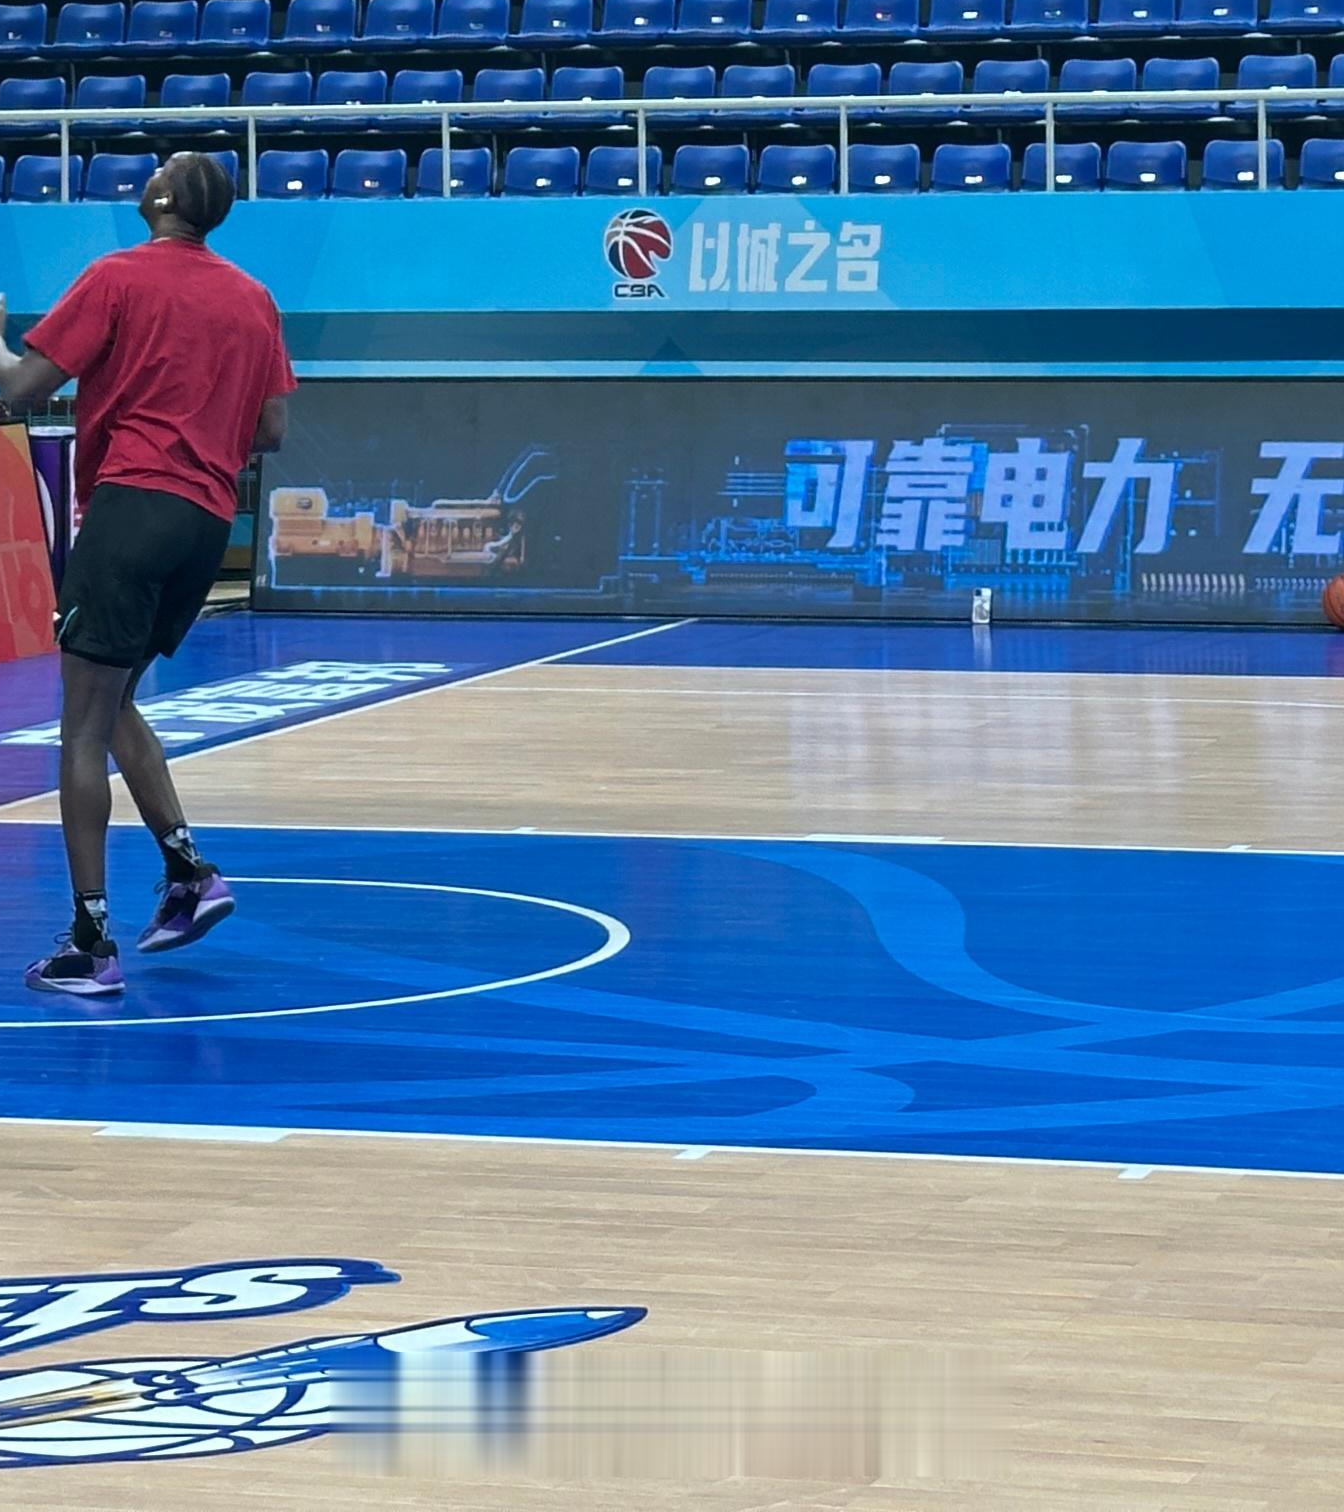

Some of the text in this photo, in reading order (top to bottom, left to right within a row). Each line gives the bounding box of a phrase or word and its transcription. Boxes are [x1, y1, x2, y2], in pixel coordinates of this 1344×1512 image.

[688, 219, 882, 293] 以城之名
[783, 437, 1178, 555] 可靠电力
